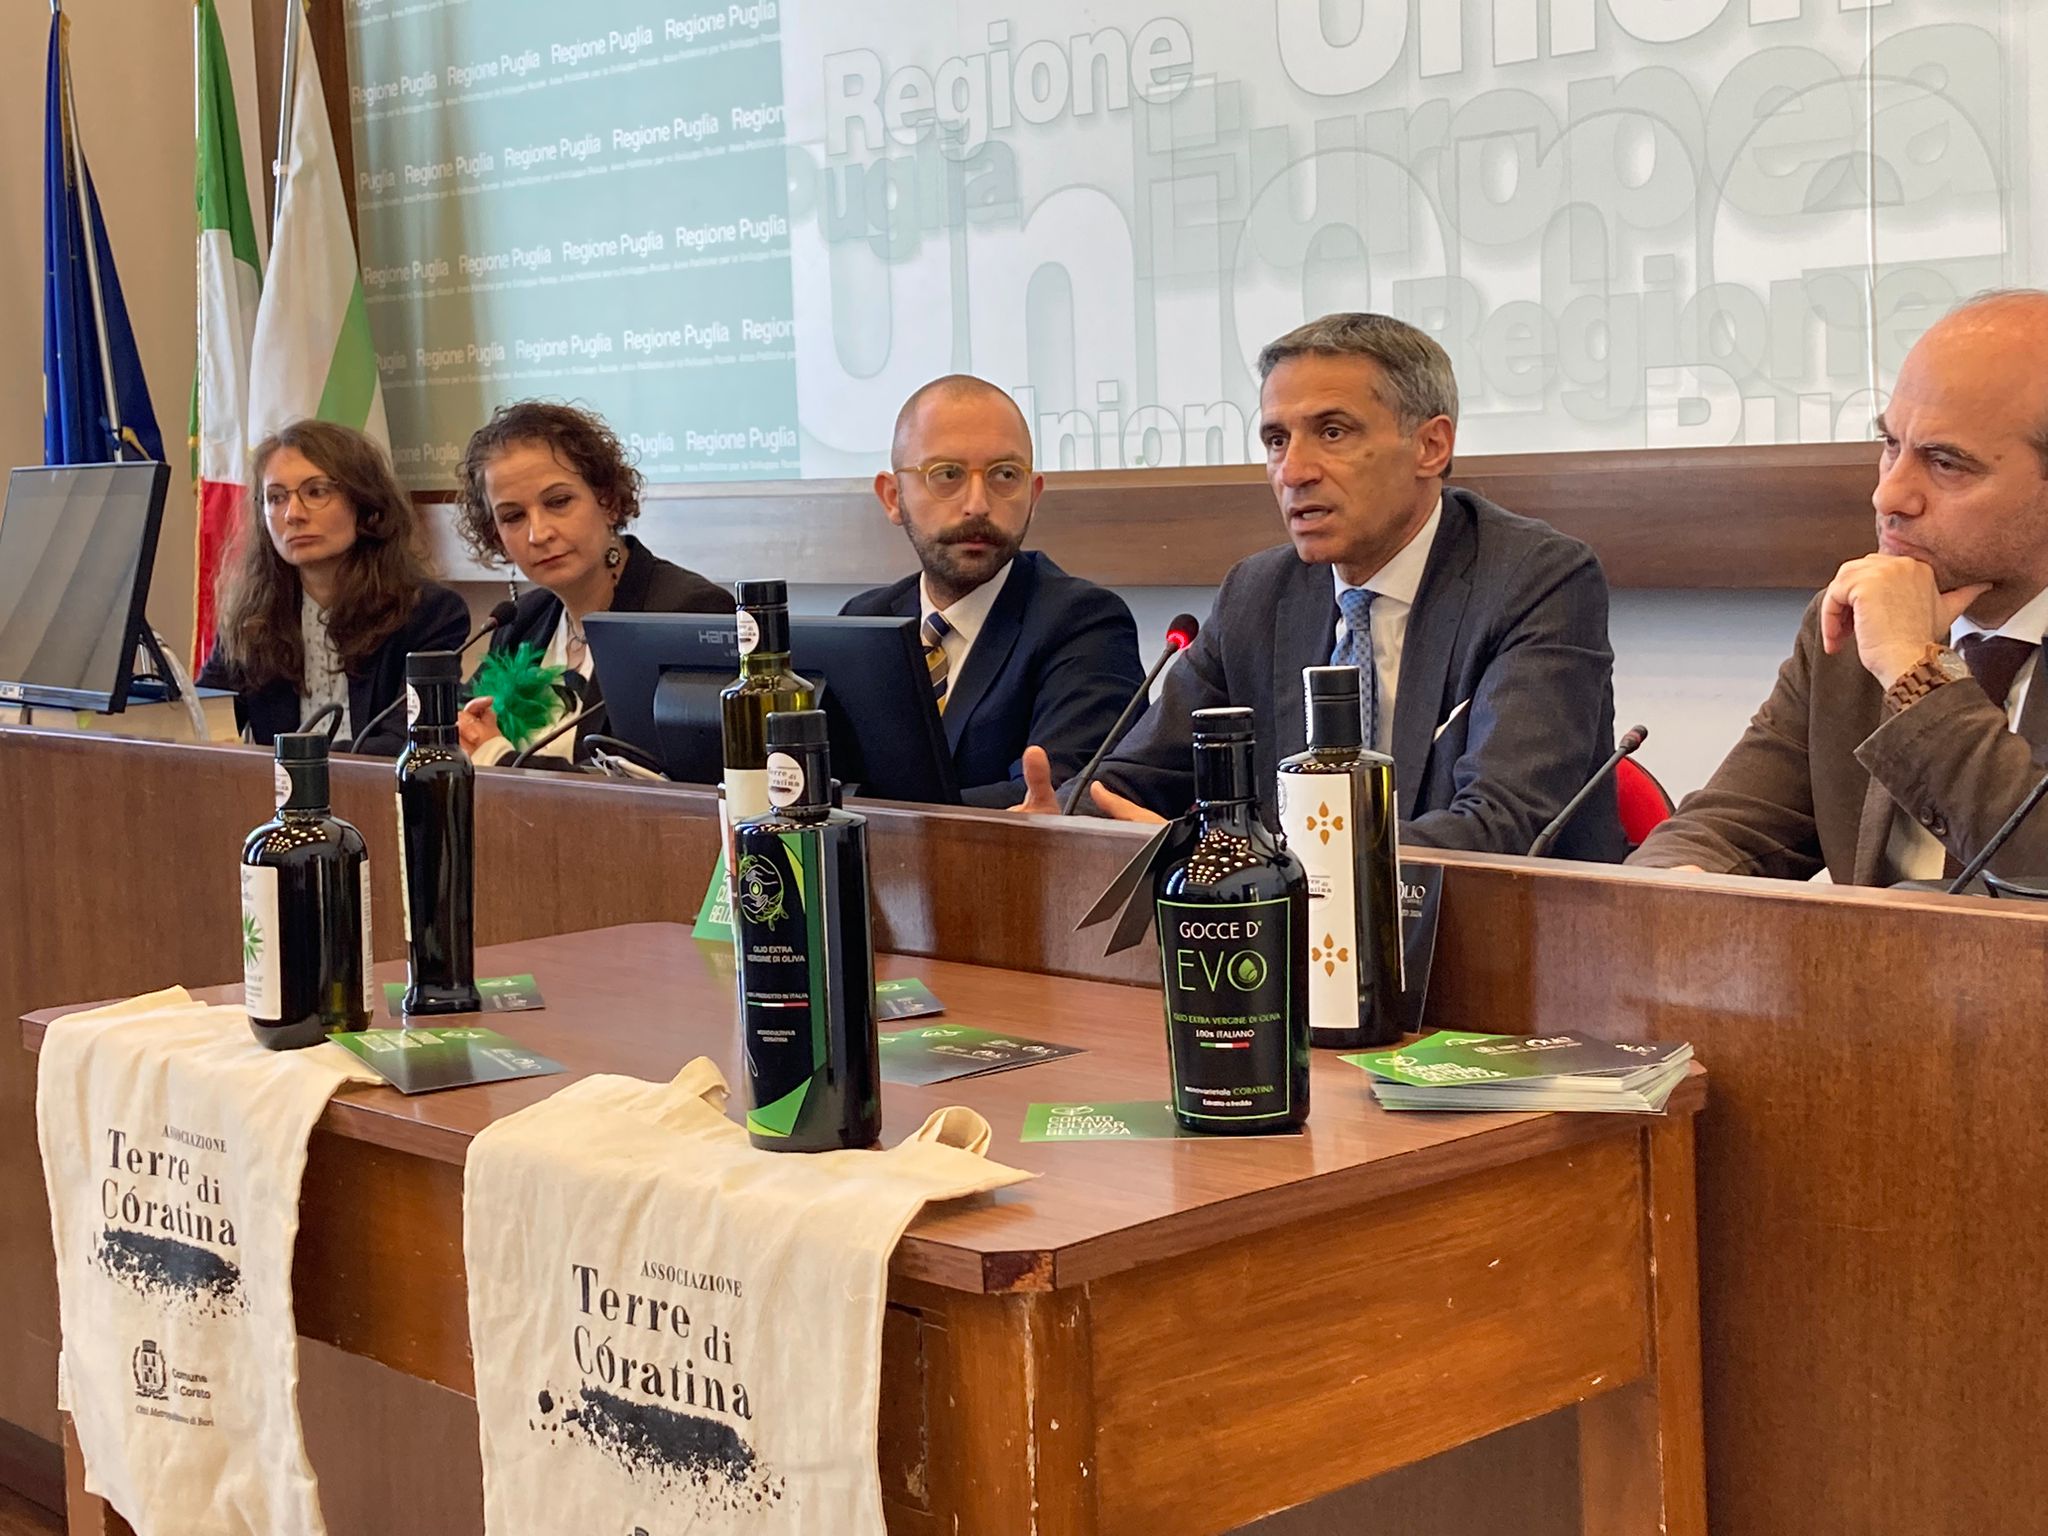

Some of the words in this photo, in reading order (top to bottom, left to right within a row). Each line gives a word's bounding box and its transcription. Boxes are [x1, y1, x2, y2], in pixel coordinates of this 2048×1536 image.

[352, 82, 398, 106] Regione
[401, 71, 437, 97] Puglia
[448, 61, 498, 88] Regione
[500, 50, 540, 77] Puglia
[551, 36, 605, 65] Regione
[608, 25, 653, 53] Puglia
[665, 13, 725, 42] Regione
[728, 0, 777, 28] Puglia
[822, 17, 1194, 162] Regione
[360, 169, 396, 193] Puglia
[404, 161, 453, 186] Regione
[455, 152, 495, 177] Puglia
[504, 144, 557, 170] Regione
[559, 133, 601, 160] Puglia
[612, 124, 670, 152] Regione
[673, 113, 719, 141] Puglia
[363, 264, 410, 289] Regione
[411, 258, 449, 283] Puglia
[458, 251, 509, 277] Regione
[511, 245, 552, 270] Puglia
[562, 238, 617, 265] Regione
[620, 230, 664, 257] Puglia
[675, 223, 736, 251] Regione
[739, 214, 787, 243] Puglia
[415, 346, 465, 370] Regione
[466, 341, 505, 367] Puglia
[515, 338, 568, 362] Regione
[570, 330, 613, 358] Puglia
[623, 327, 681, 354] Regione
[684, 320, 730, 349] Puglia
[424, 441, 460, 466] Puglia
[630, 431, 674, 458] Puglia
[686, 428, 746, 456] Regione
[749, 425, 797, 453] Puglia
[1179, 921, 1240, 939] GOCCE
[769, 945, 794, 954] EXTRA
[773, 955, 780, 963] DI
[781, 955, 806, 963] OLIVA
[1177, 949, 1267, 992] EVO
[1189, 1015, 1211, 1025] EXTRA
[1212, 1017, 1247, 1025] VERGINE
[1248, 1015, 1257, 1023] DI
[1259, 1013, 1281, 1022] OLIVA
[1216, 1029, 1255, 1038] ITALIANO
[1233, 1084, 1275, 1096] CORATINA
[1045, 1128, 1131, 1136] BELLEZZA
[1046, 1121, 1125, 1129] CULTIVAR
[1048, 1115, 1114, 1123] CORATO
[107, 1128, 190, 1186] Terre
[197, 1173, 221, 1206] di
[102, 1178, 237, 1247] Córatina
[640, 1260, 743, 1299] ASSOCIAZIONE
[572, 1264, 691, 1339] Terre
[703, 1324, 734, 1366] di
[573, 1325, 753, 1421] Córatina
[180, 1385, 212, 1400] Corato
